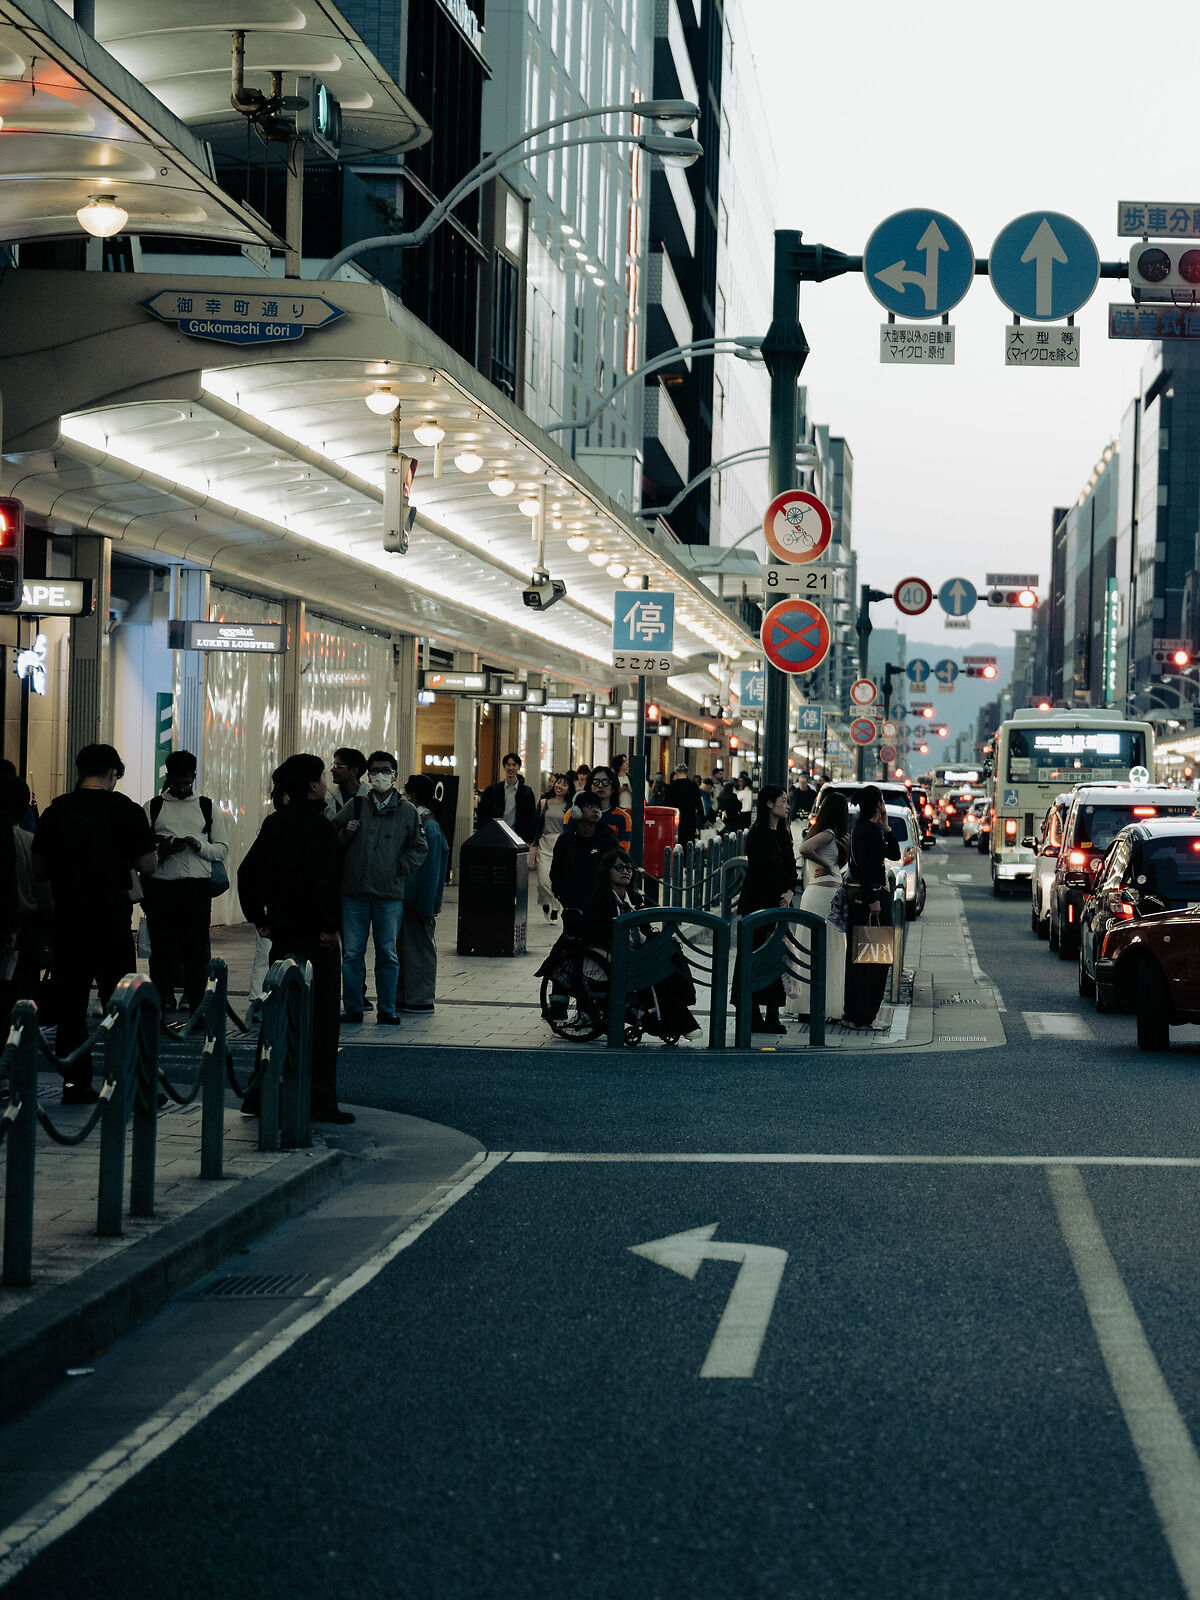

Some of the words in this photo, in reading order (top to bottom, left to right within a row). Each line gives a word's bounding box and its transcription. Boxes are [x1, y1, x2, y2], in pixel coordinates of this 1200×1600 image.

[177, 297, 304, 318] 御幸町通り
[189, 320, 260, 335] Gokomachi
[265, 324, 290, 336] dori
[883, 330, 952, 344] 大型等以外の自動車
[902, 587, 924, 605] 40
[623, 601, 665, 642] 停
[197, 638, 229, 648] LUKE'S
[231, 638, 275, 649] LOBSTER
[614, 656, 671, 671] ここから
[857, 943, 894, 962] ZARA
